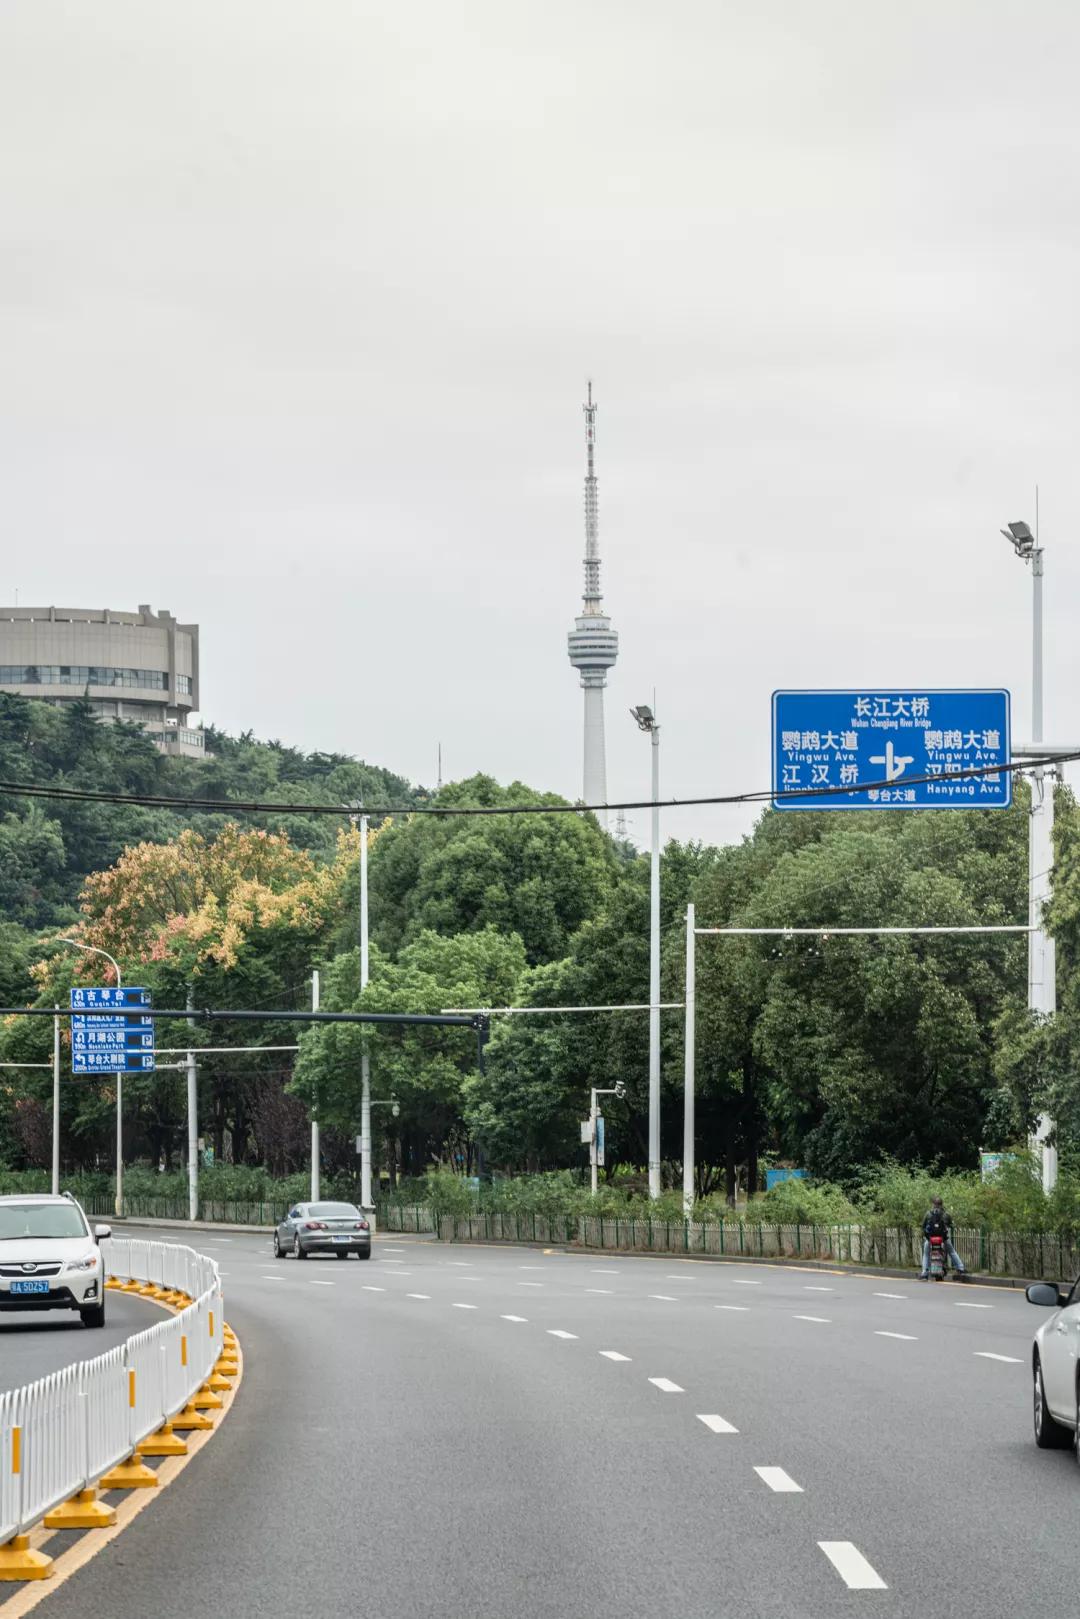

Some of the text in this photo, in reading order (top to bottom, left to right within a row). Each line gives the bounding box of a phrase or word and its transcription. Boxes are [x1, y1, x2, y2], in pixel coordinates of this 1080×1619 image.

[854, 697, 930, 717] 长江大桥
[851, 718, 931, 730] Wuhan Changjiang River Bridge
[782, 730, 859, 751] 鹦鹉大道
[924, 730, 1000, 750] 鹦鹉大道
[788, 752, 857, 764] Yingwu Ave.
[928, 751, 998, 762] Yingwu Ave.
[782, 764, 859, 784] 江汉桥
[925, 763, 1000, 783] 汉阳大道
[867, 789, 916, 802] 琴台大道
[927, 784, 1002, 796] Hanyang Ave.
[87, 990, 124, 1001] 古琴台
[88, 1032, 125, 1043] 月湖公园
[88, 1054, 126, 1065] 琴台大剧院
